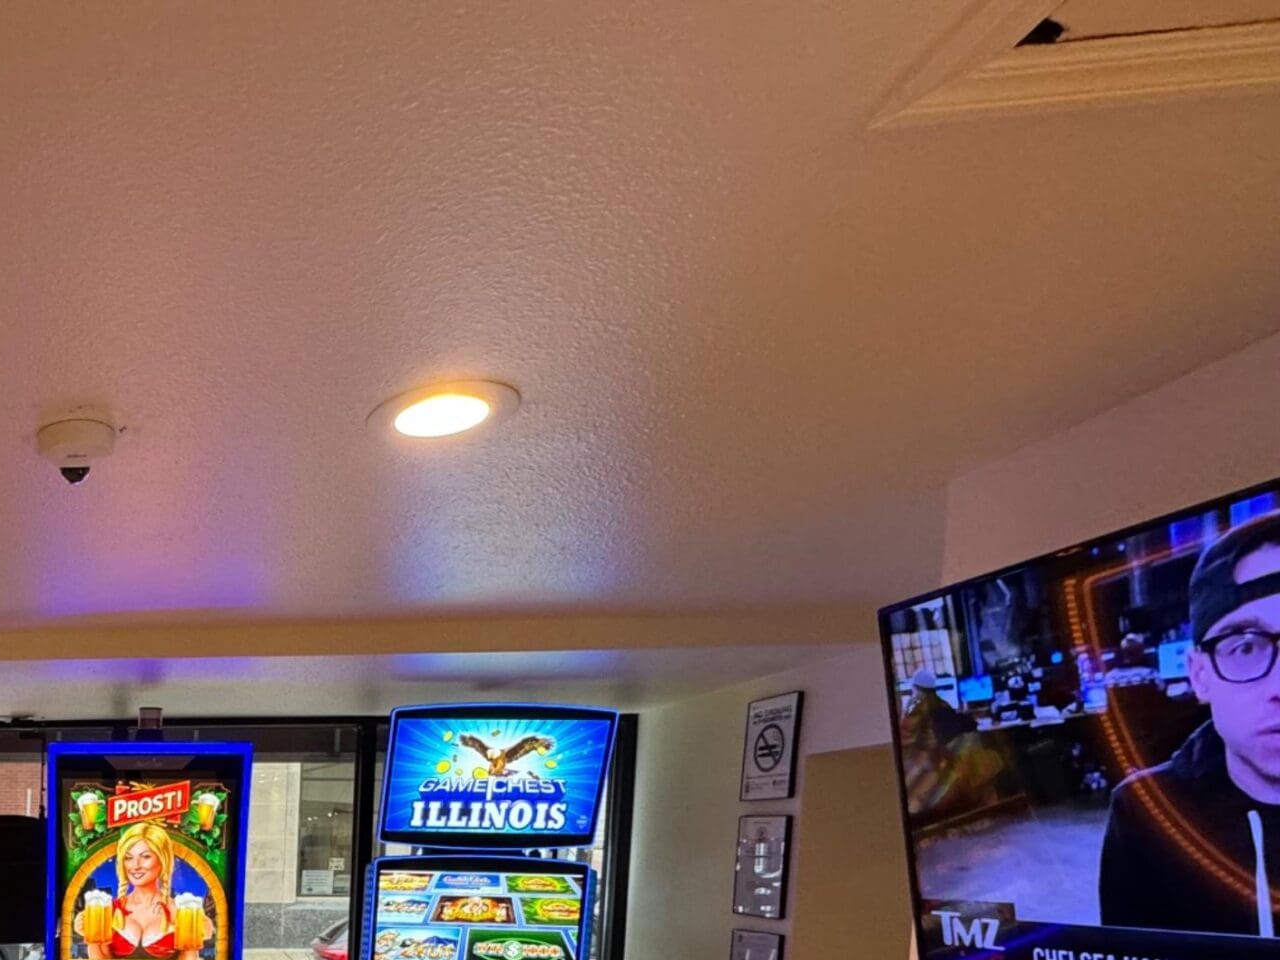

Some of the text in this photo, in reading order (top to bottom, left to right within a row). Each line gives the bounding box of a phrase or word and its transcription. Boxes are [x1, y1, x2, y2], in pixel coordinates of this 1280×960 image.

[113, 789, 183, 822] PROST!
[410, 799, 567, 830] ILLINOIS
[930, 910, 1006, 952] TMZ
